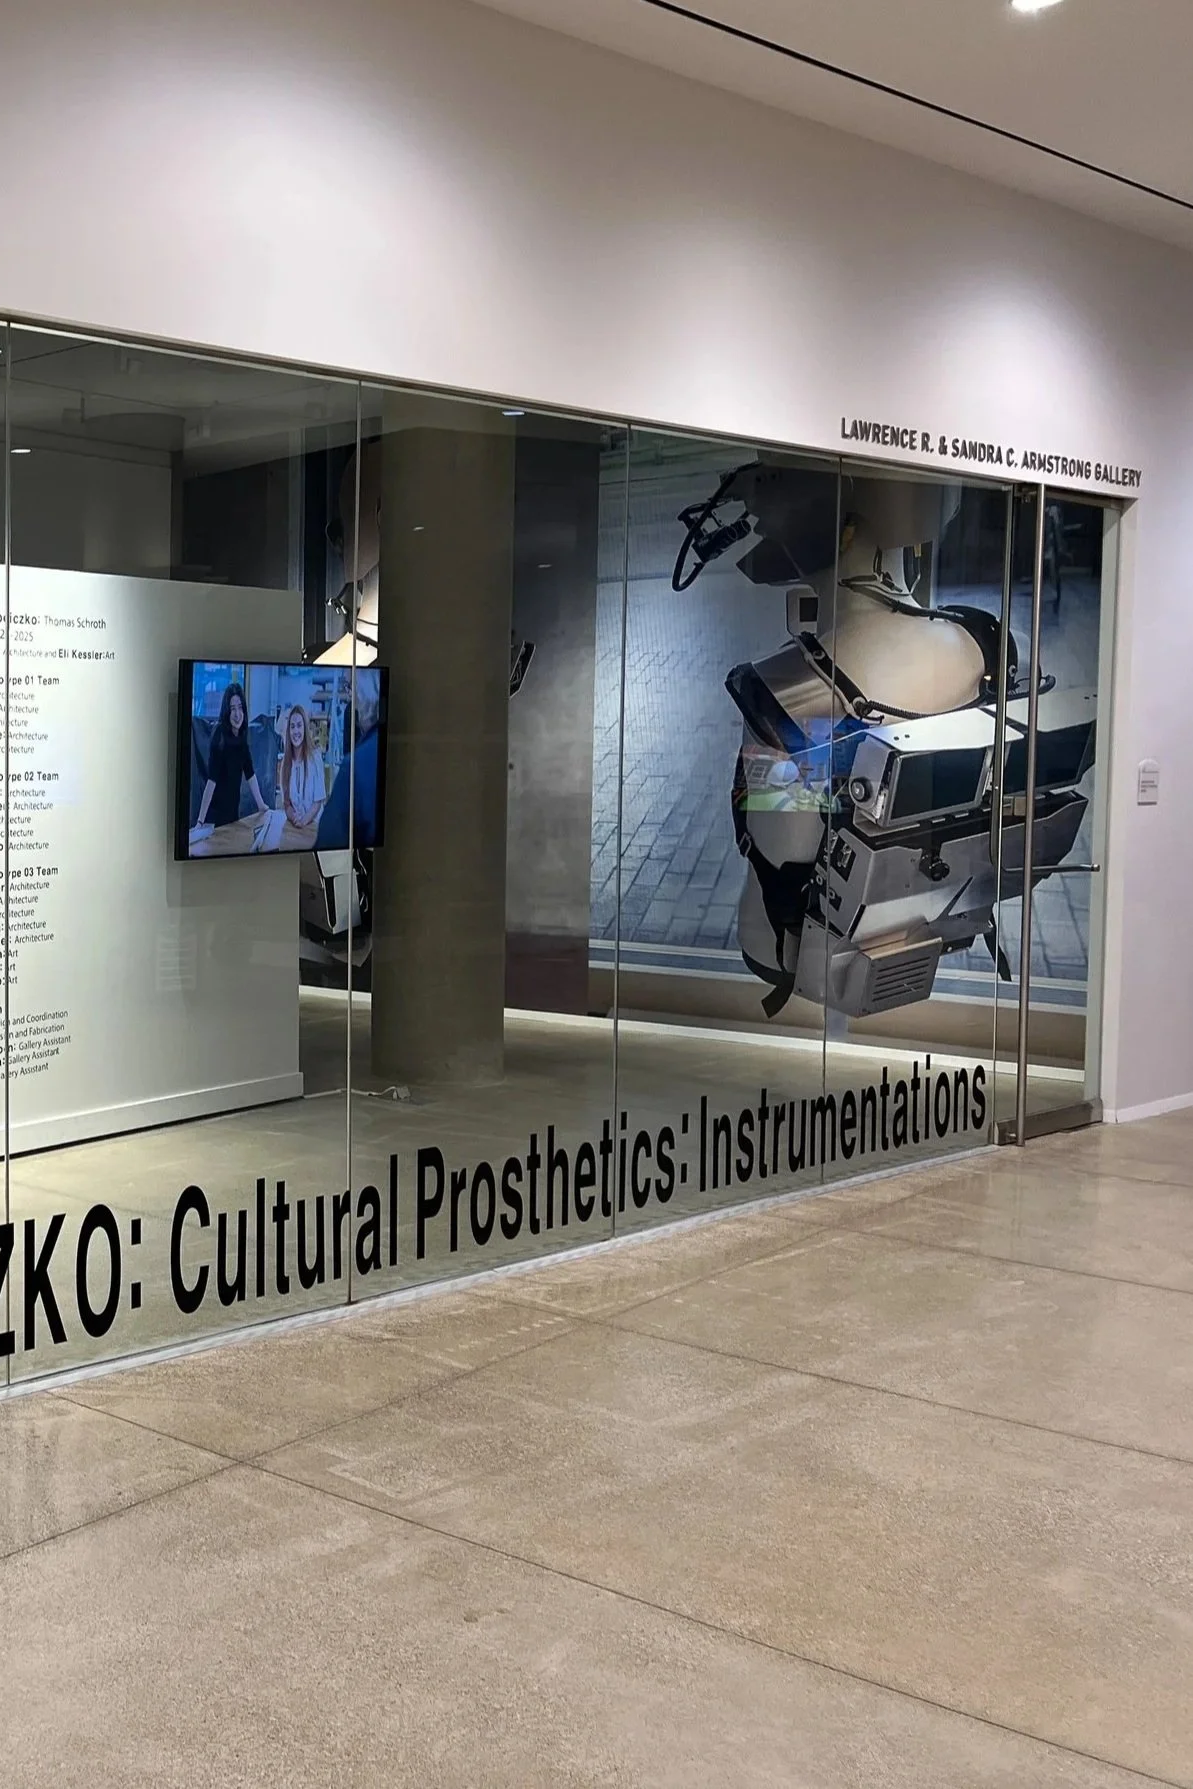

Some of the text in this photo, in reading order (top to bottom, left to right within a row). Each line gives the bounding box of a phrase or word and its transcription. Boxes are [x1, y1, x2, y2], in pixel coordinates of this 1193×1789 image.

[841, 417, 1142, 488] LAWRENCE R. & SANDRA C. ARMSTRONG GALLERY
[45, 615, 74, 627] Thomas
[77, 617, 106, 629] Schroth
[59, 649, 69, 658] Eli
[25, 676, 34, 685] 01
[38, 676, 60, 685] Team
[25, 772, 33, 780] 02
[37, 771, 59, 780] Team
[8, 789, 45, 797] rchitecture
[13, 802, 53, 810] Architecture
[24, 868, 34, 877] 03
[37, 866, 58, 876] Team
[10, 882, 49, 891] Architecture
[15, 933, 54, 944] Architecture
[12, 1015, 25, 1025] and
[26, 1010, 68, 1023] Coordination
[15, 1028, 28, 1038] and
[29, 1024, 65, 1036] Fabrication
[18, 1037, 41, 1050] Gallery
[43, 1035, 71, 1047] Assistant
[31, 1048, 59, 1060] Assistant
[20, 1062, 49, 1075] Assistant
[170, 1154, 398, 1314] Cultural
[416, 1110, 690, 1260] Prosthetics:
[699, 1054, 987, 1193] Instrumentations
